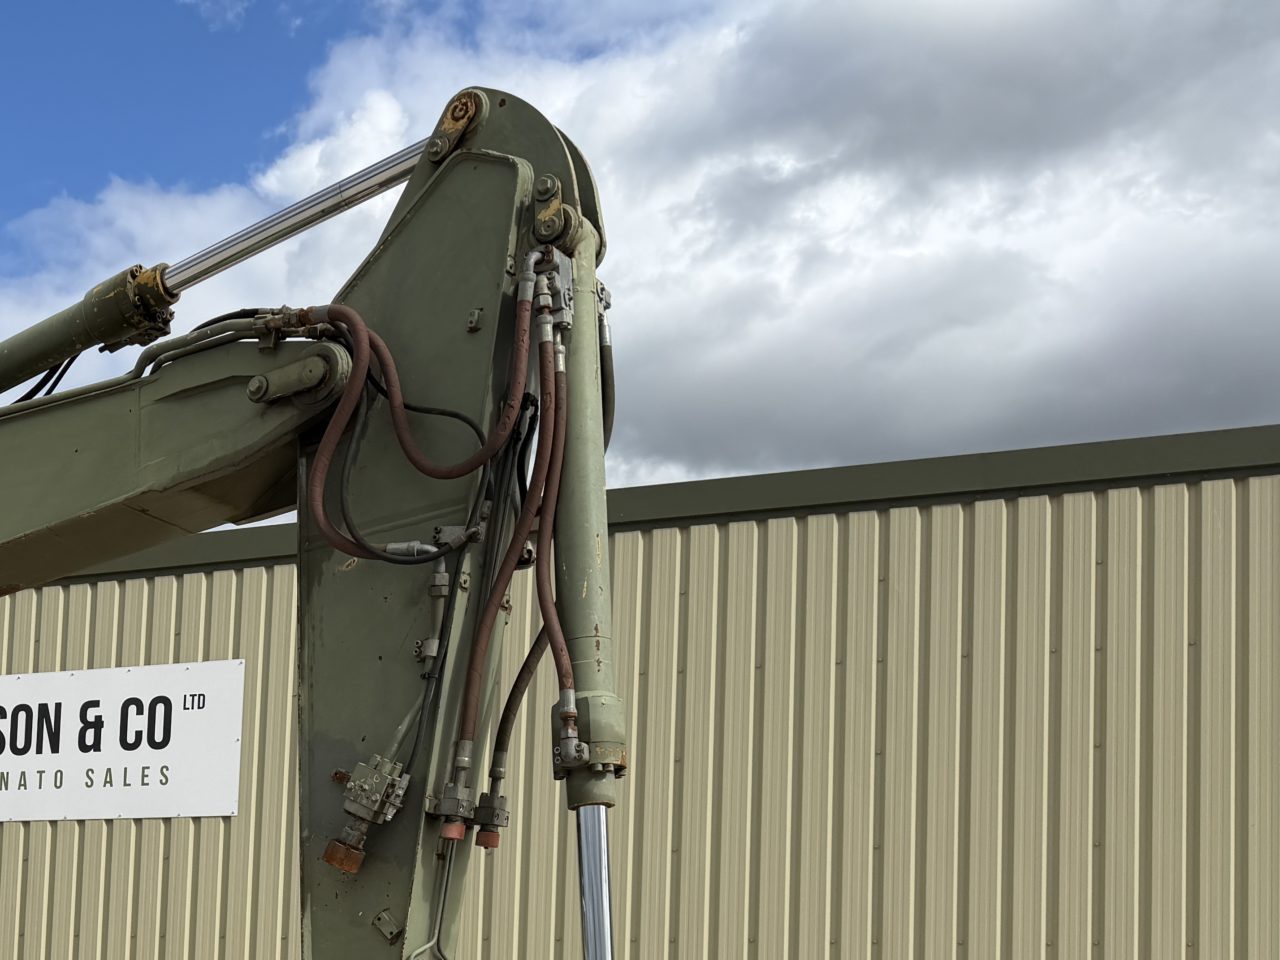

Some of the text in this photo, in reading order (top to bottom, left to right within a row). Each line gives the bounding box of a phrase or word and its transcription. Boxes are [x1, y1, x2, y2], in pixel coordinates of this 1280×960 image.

[77, 699, 105, 754] &
[118, 694, 174, 752] CO
[182, 693, 207, 711] LTD
[0, 769, 64, 791] NATO
[85, 765, 171, 789] SALES
